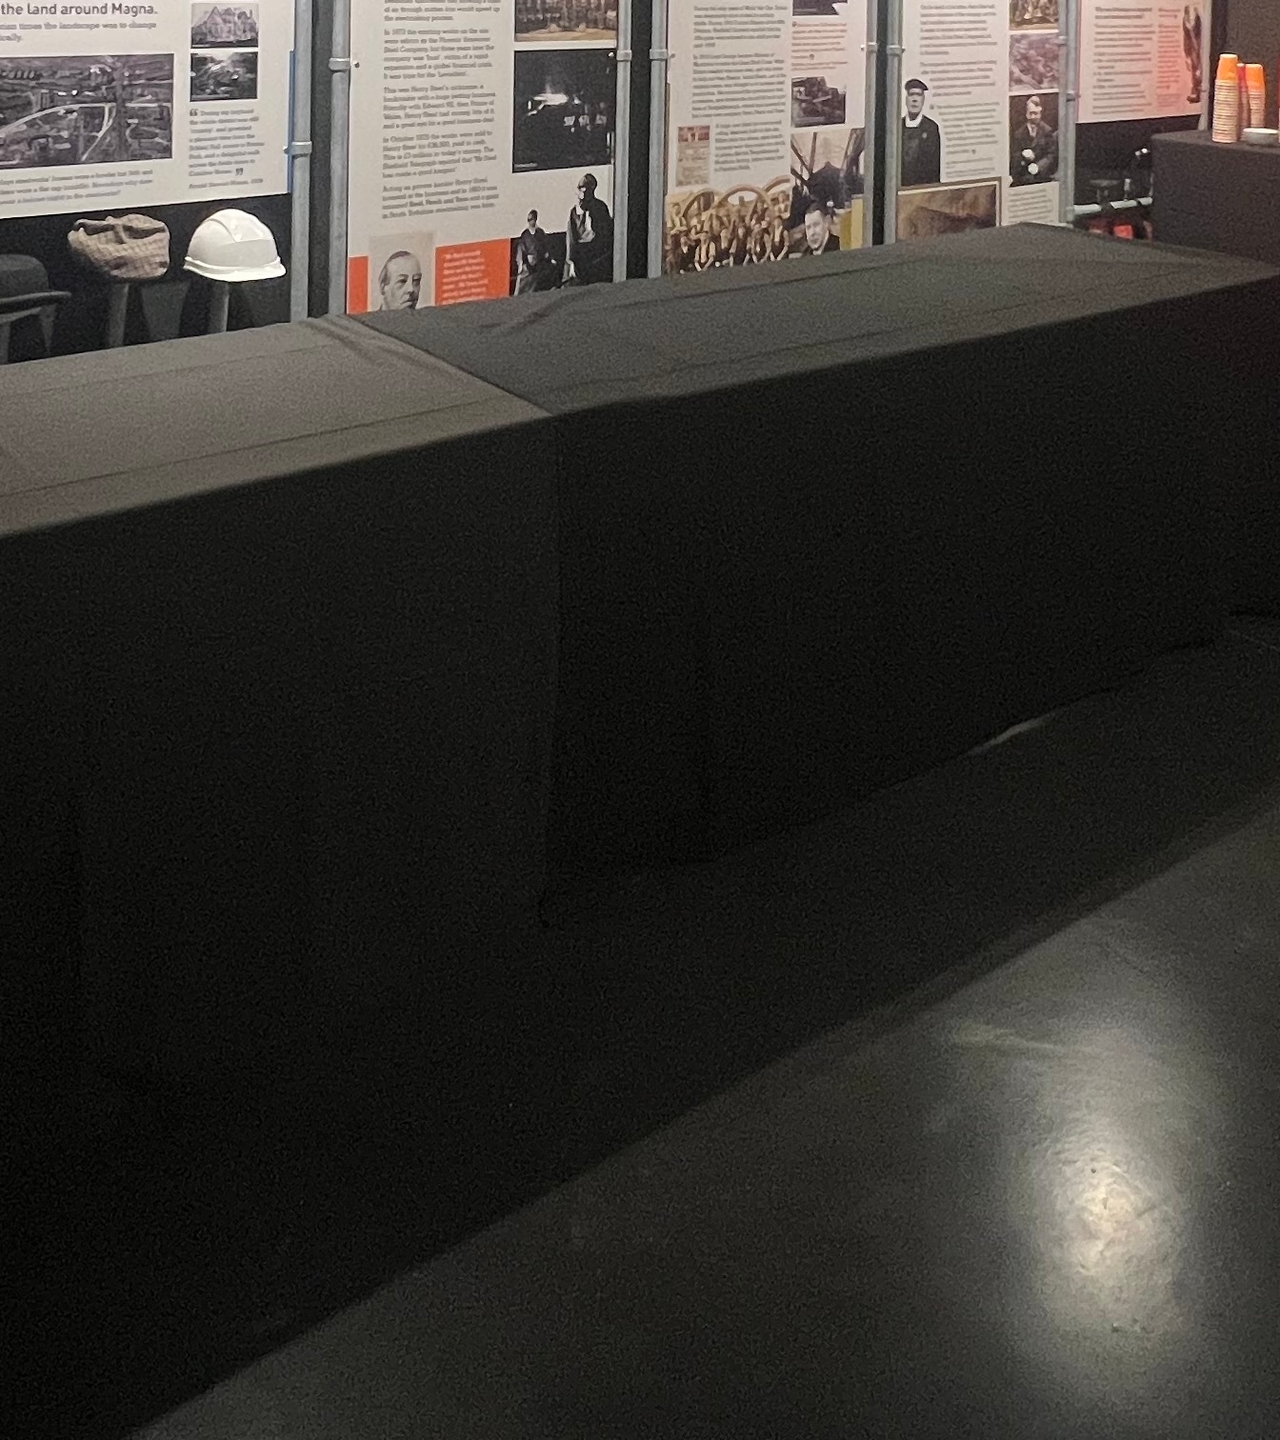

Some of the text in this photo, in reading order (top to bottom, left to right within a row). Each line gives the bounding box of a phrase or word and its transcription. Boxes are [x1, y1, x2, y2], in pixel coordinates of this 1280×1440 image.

[1, 3, 23, 15] the
[27, 3, 57, 15] land
[61, 3, 108, 15] around
[112, 3, 157, 17] Magna.
